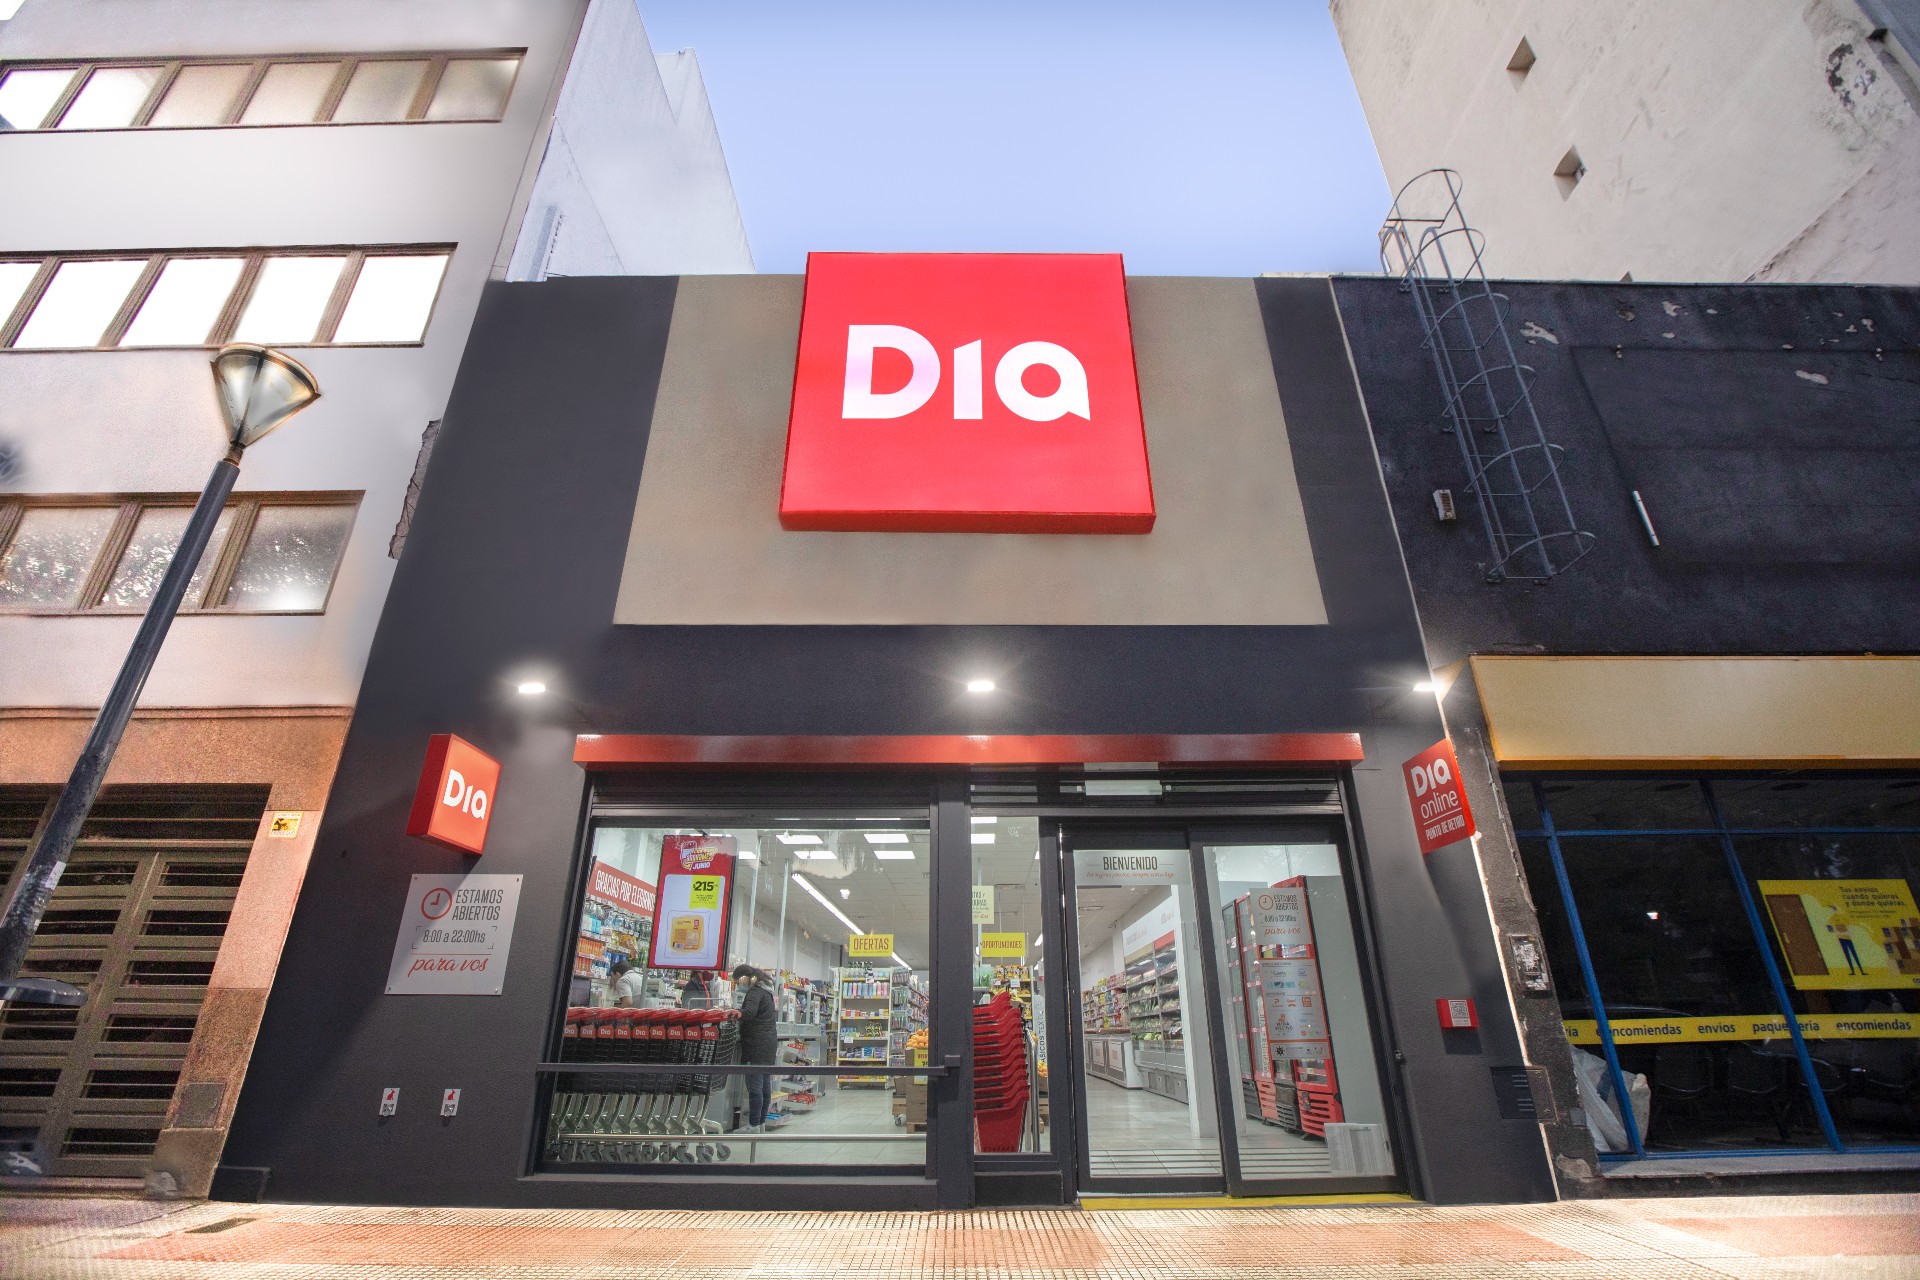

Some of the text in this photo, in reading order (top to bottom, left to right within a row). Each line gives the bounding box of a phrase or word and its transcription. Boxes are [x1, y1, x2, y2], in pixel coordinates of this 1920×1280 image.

[1421, 790, 1459, 819] online
[1425, 814, 1466, 840] PUNTO DE RETIRO
[1103, 856, 1158, 870] BIENVENIDO
[595, 870, 620, 898] GRACIAS
[620, 880, 632, 903] POR
[456, 889, 504, 903] ESTAMOS
[452, 906, 501, 920] ABIERTOS
[423, 930, 486, 942] 8:00 a 22:00hs
[853, 938, 889, 950] OFERTAS
[408, 958, 489, 977] para vos
[1836, 1019, 1912, 1031] encomiendas
